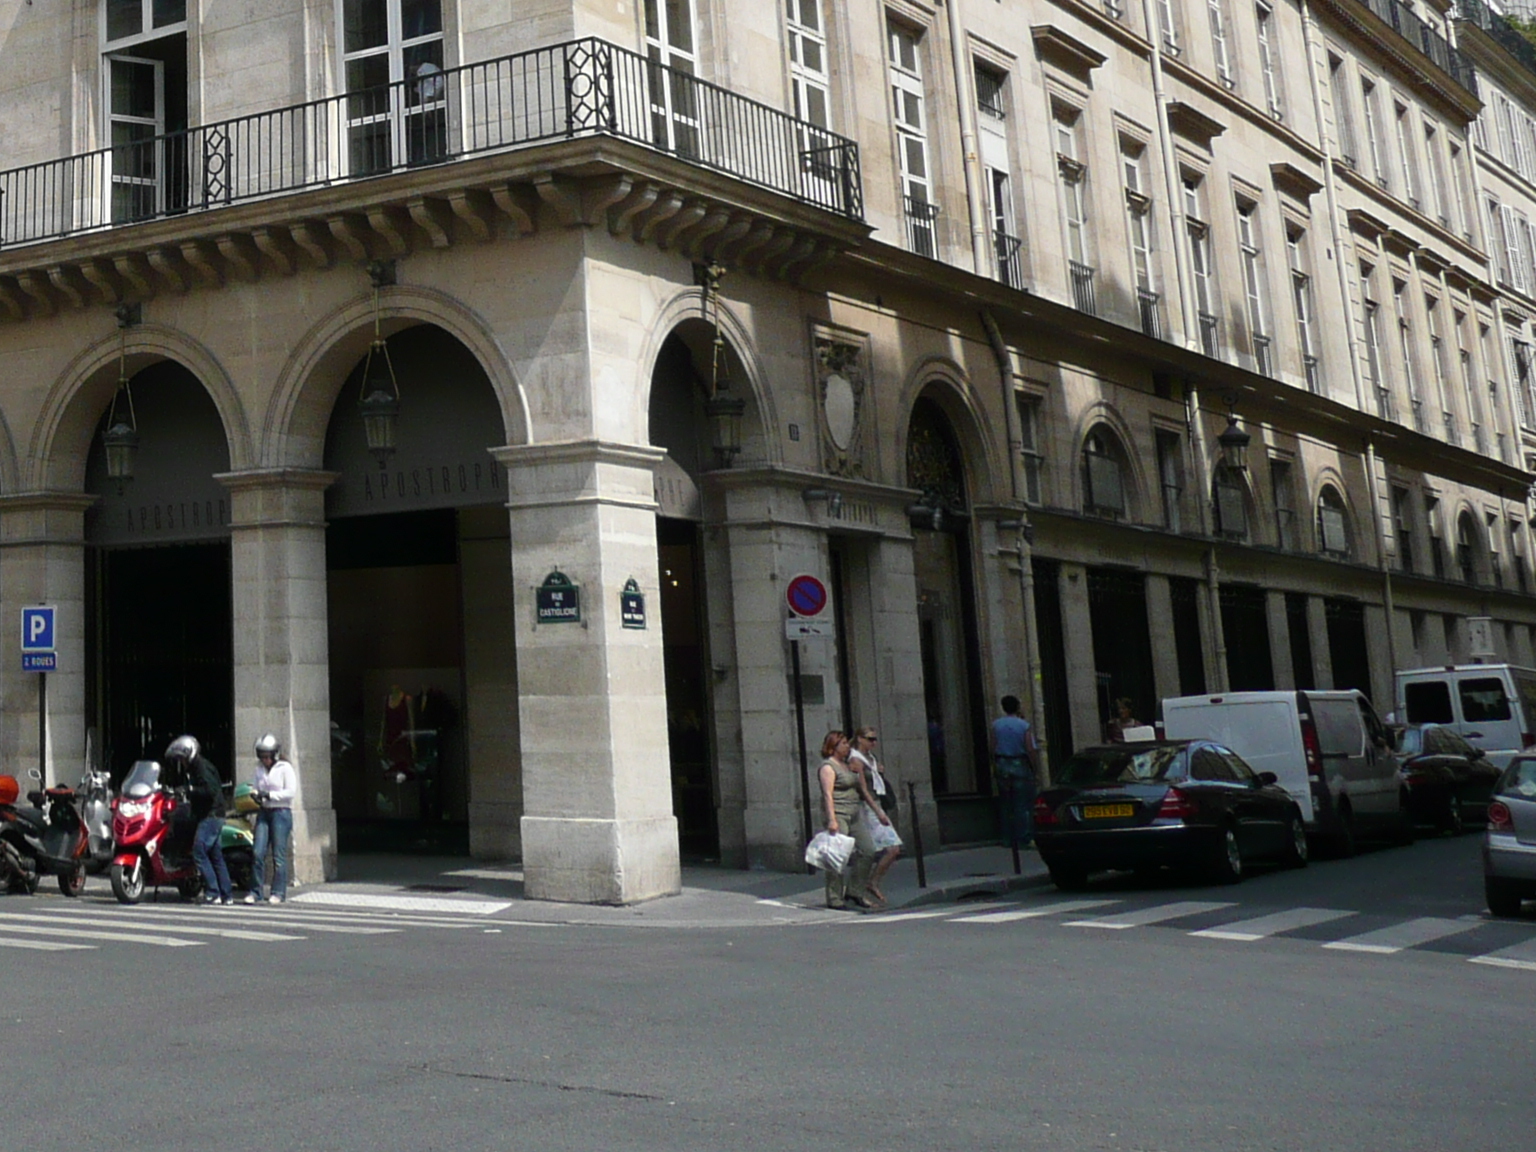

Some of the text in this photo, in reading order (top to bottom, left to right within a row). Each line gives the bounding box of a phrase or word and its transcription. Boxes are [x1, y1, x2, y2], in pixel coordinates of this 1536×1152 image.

[551, 592, 563, 601] RUE
[539, 608, 577, 617] CASTIGLIONE
[30, 614, 46, 643] P
[24, 656, 54, 667] 2 ROUES
